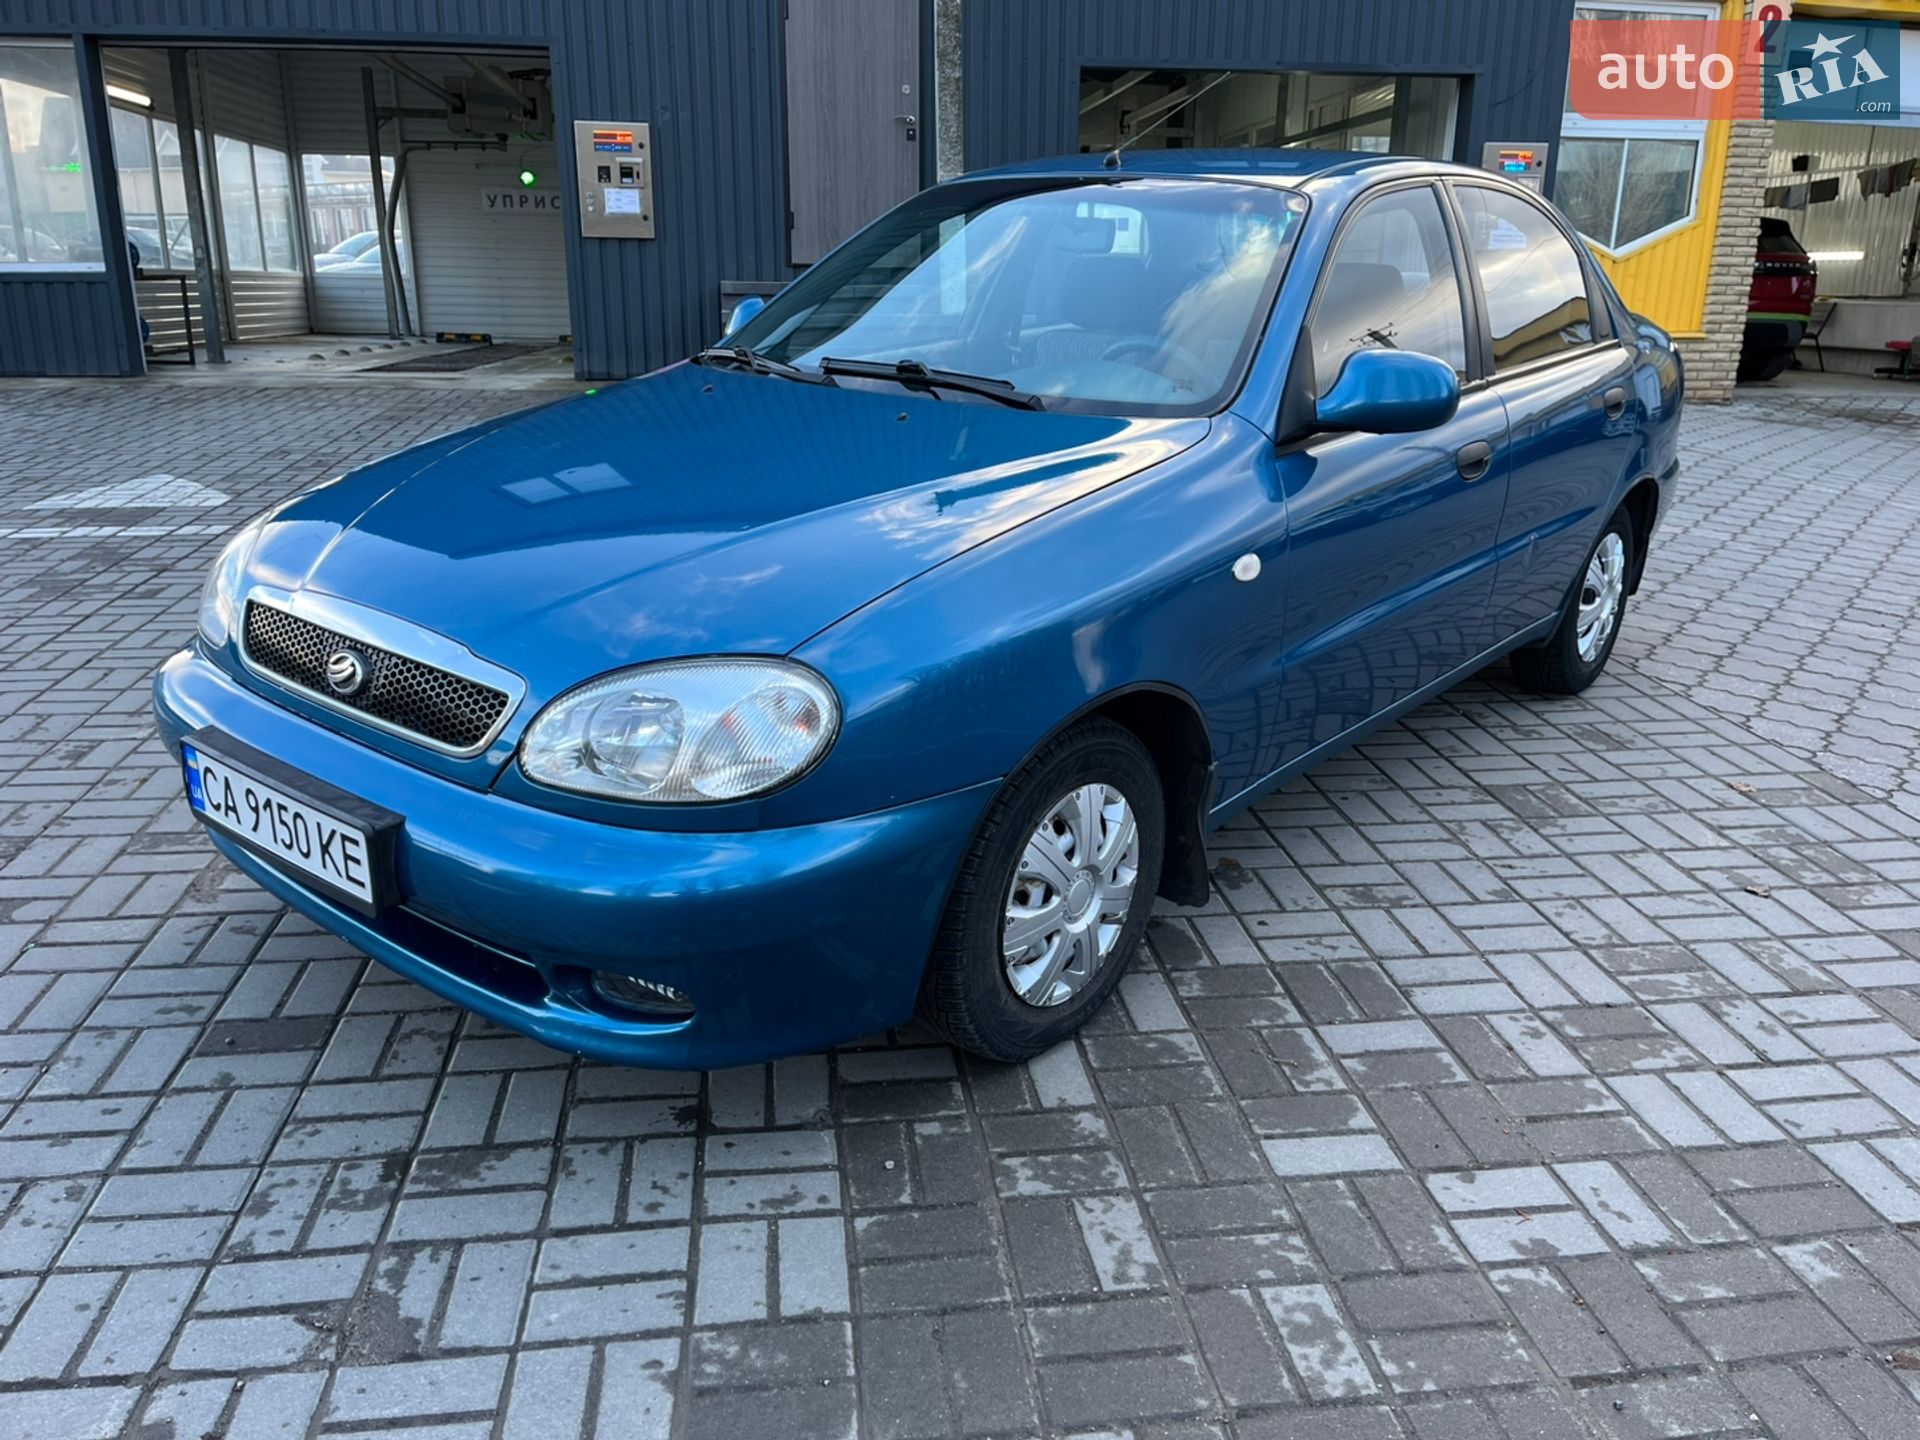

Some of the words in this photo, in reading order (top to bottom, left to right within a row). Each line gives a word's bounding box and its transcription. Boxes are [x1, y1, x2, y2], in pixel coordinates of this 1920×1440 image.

[1753, 4, 1783, 54] 2
[191, 784, 204, 801] UA
[203, 766, 241, 825] CA
[244, 788, 311, 859] 9150
[315, 821, 366, 888] KE
